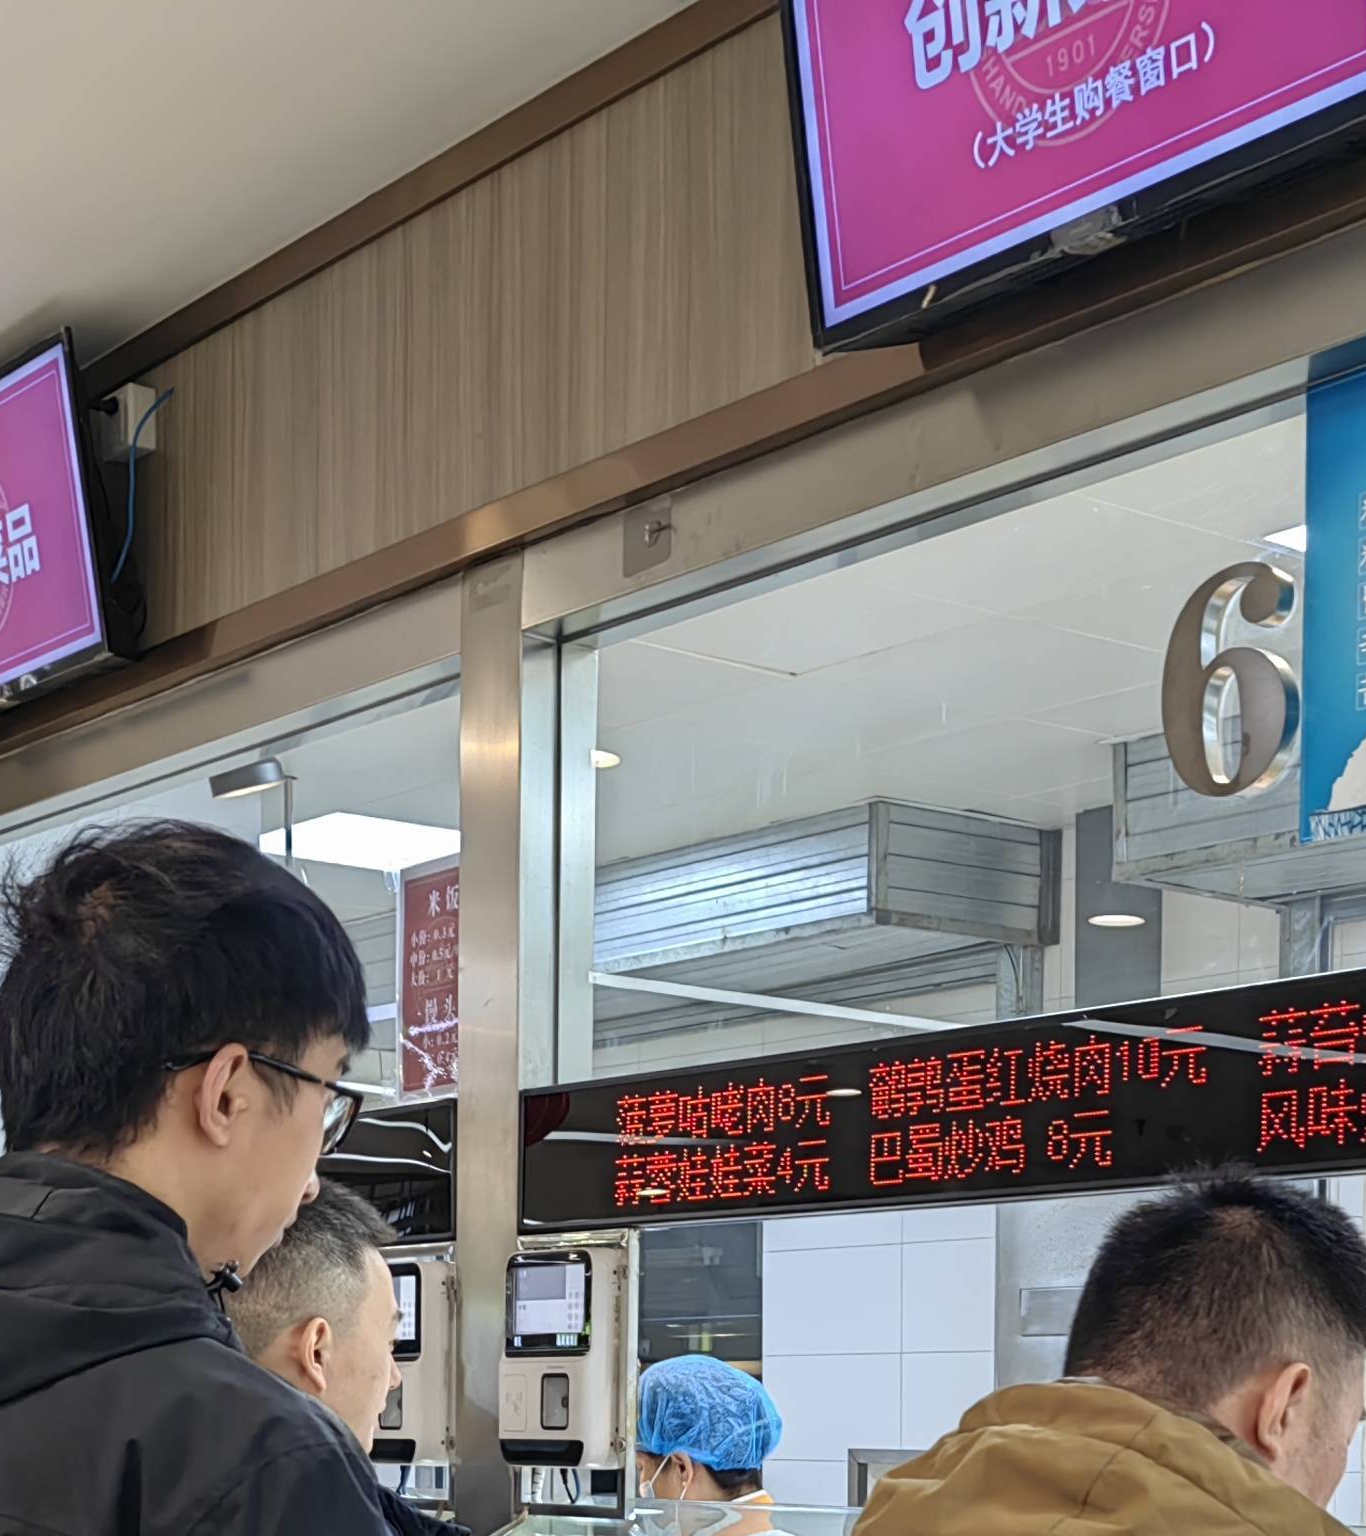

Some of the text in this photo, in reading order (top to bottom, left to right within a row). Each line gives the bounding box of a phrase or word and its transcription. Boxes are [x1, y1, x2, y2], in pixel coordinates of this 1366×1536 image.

[1161, 561, 1301, 798] 6
[870, 1109, 1113, 1187] 巴蜀炒鸡 8元
